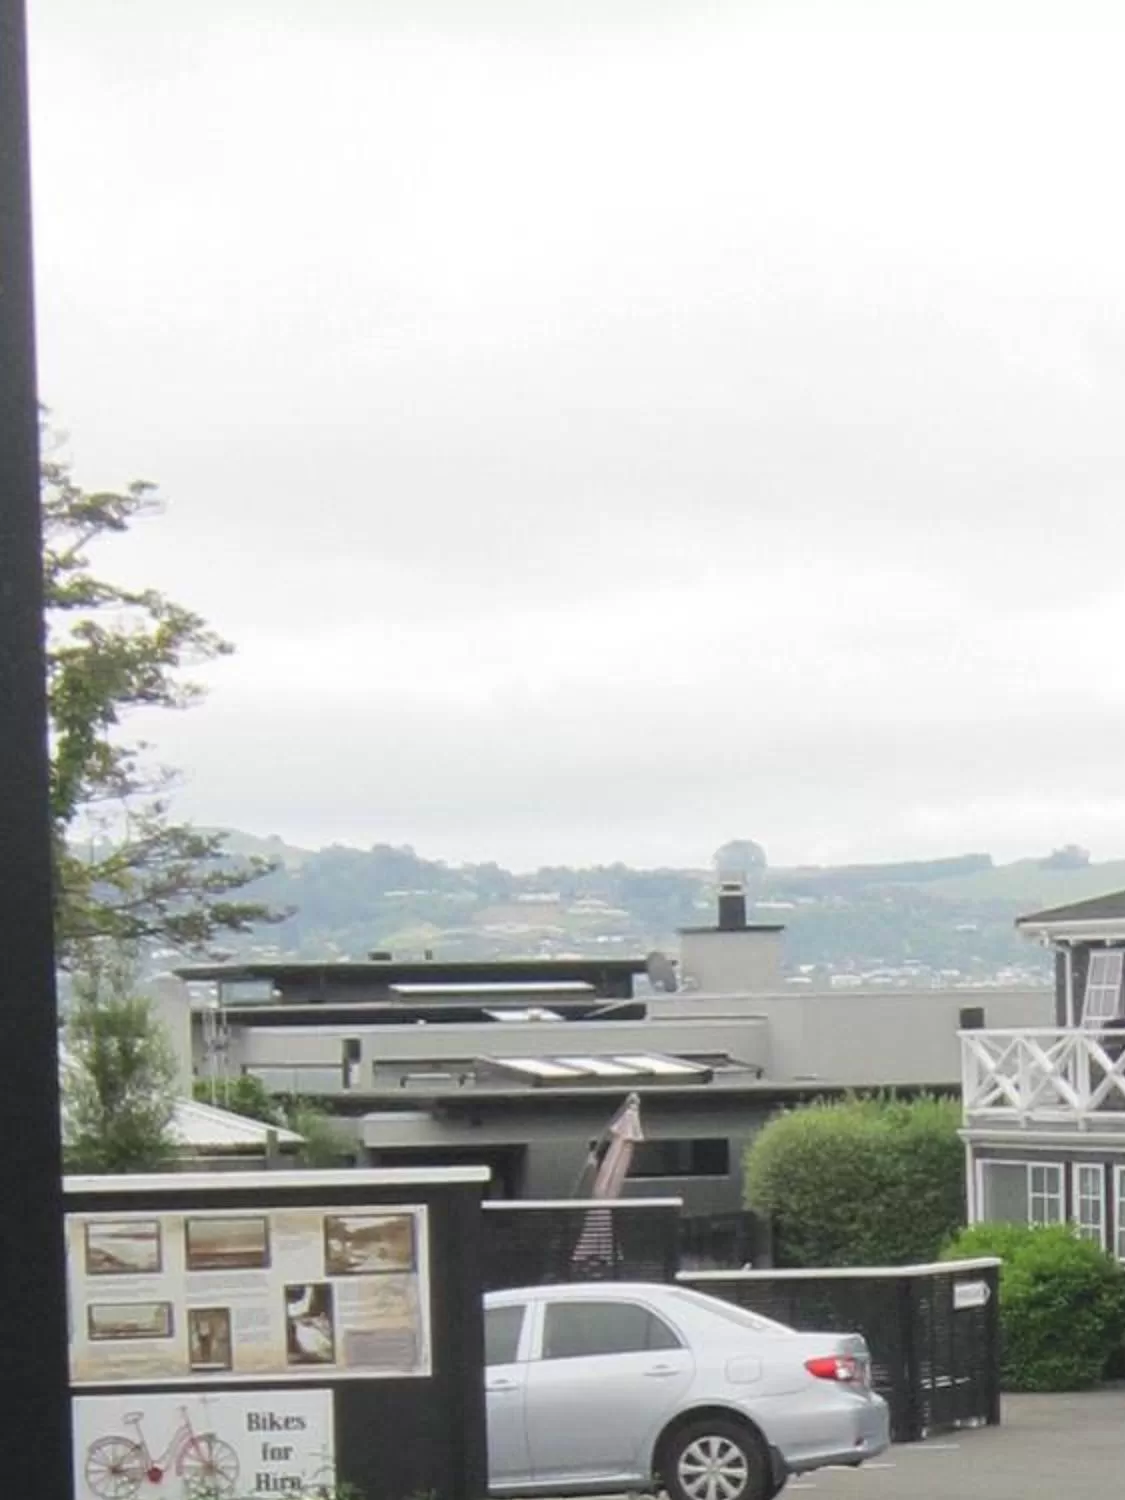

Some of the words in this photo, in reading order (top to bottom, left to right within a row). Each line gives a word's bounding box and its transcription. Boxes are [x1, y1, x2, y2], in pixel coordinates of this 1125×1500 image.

[246, 1411, 307, 1432] Bikes
[261, 1442, 294, 1461] for
[256, 1472, 302, 1492] Hire
